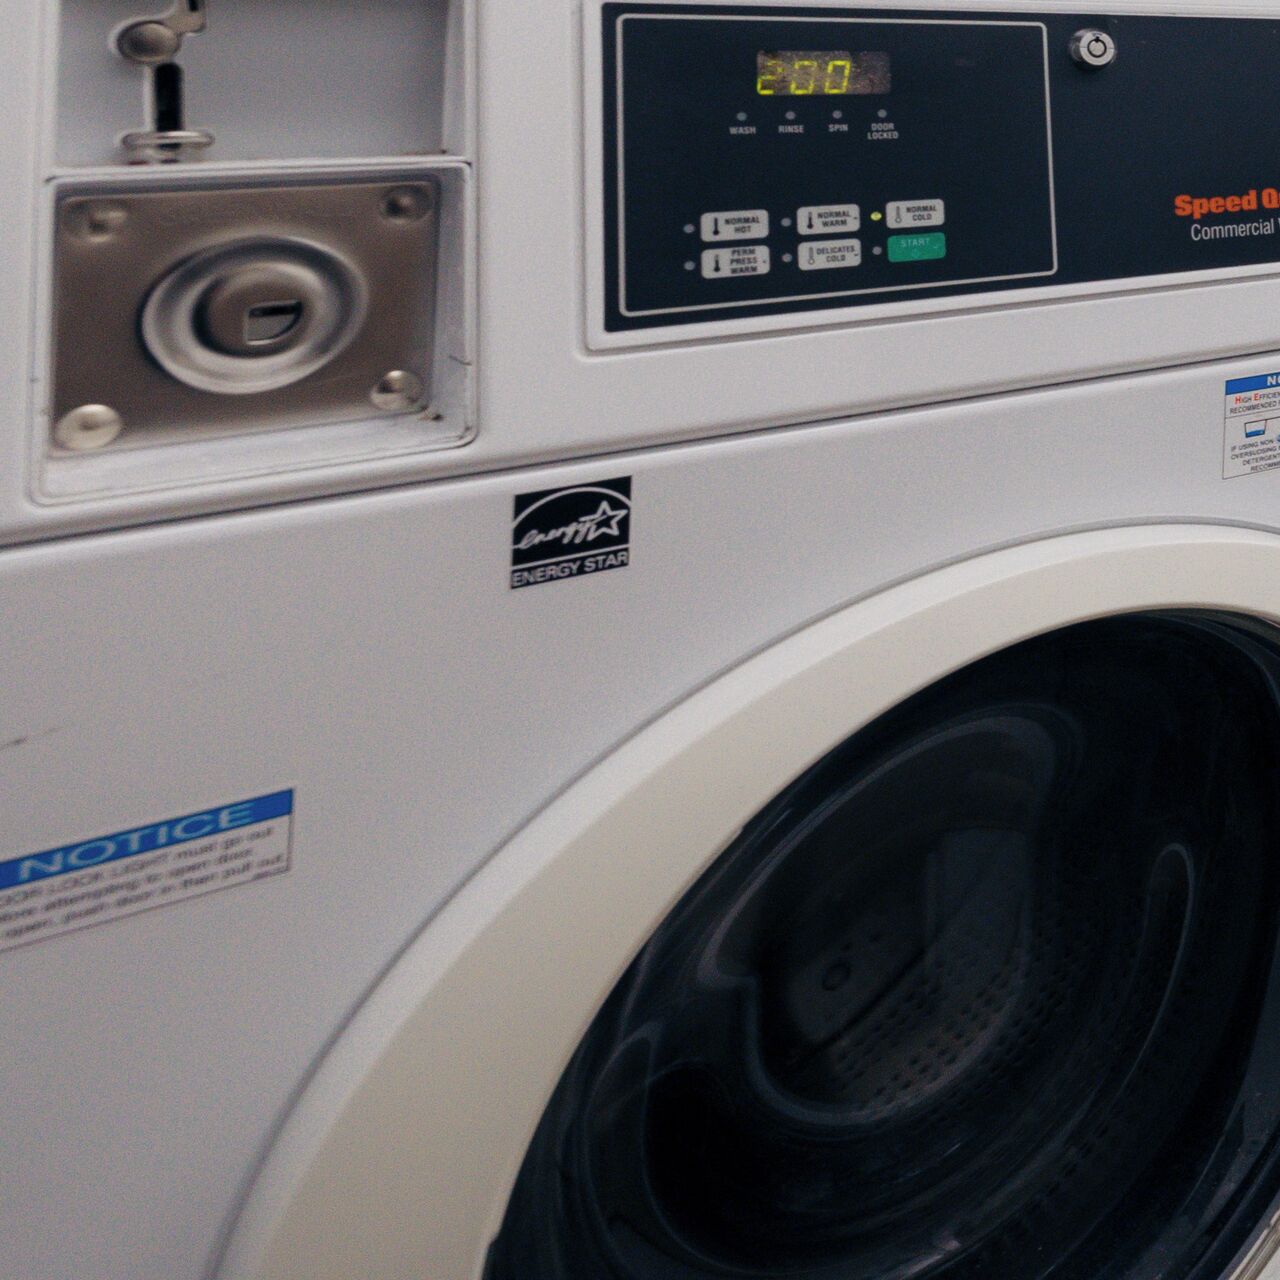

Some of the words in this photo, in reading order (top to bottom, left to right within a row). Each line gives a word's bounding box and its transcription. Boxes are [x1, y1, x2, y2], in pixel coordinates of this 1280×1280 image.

[729, 126, 756, 135] WASH
[778, 125, 804, 134] RINSE
[828, 124, 848, 132] SPIN
[871, 122, 895, 131] DOOR
[867, 131, 899, 140] LOCKED
[906, 205, 937, 213] NORMAL
[1174, 190, 1258, 219] Speed
[817, 211, 851, 220] NORMAL
[912, 213, 932, 221] COLD
[725, 216, 761, 225] NORMAL
[822, 219, 848, 228] WARM
[734, 225, 752, 234] HOT
[1191, 218, 1274, 241] Commercial
[901, 238, 930, 248] START
[731, 248, 756, 256] PERM
[816, 246, 855, 255] DELICATES
[730, 256, 757, 265] PRESS
[826, 254, 846, 263] COLD
[730, 265, 757, 275] WARM
[1230, 401, 1277, 414] RECOMMENDED
[1238, 441, 1258, 451] USING
[511, 561, 581, 586] ENERGY
[584, 552, 629, 572] STAR
[19, 802, 254, 882] NOTICE
